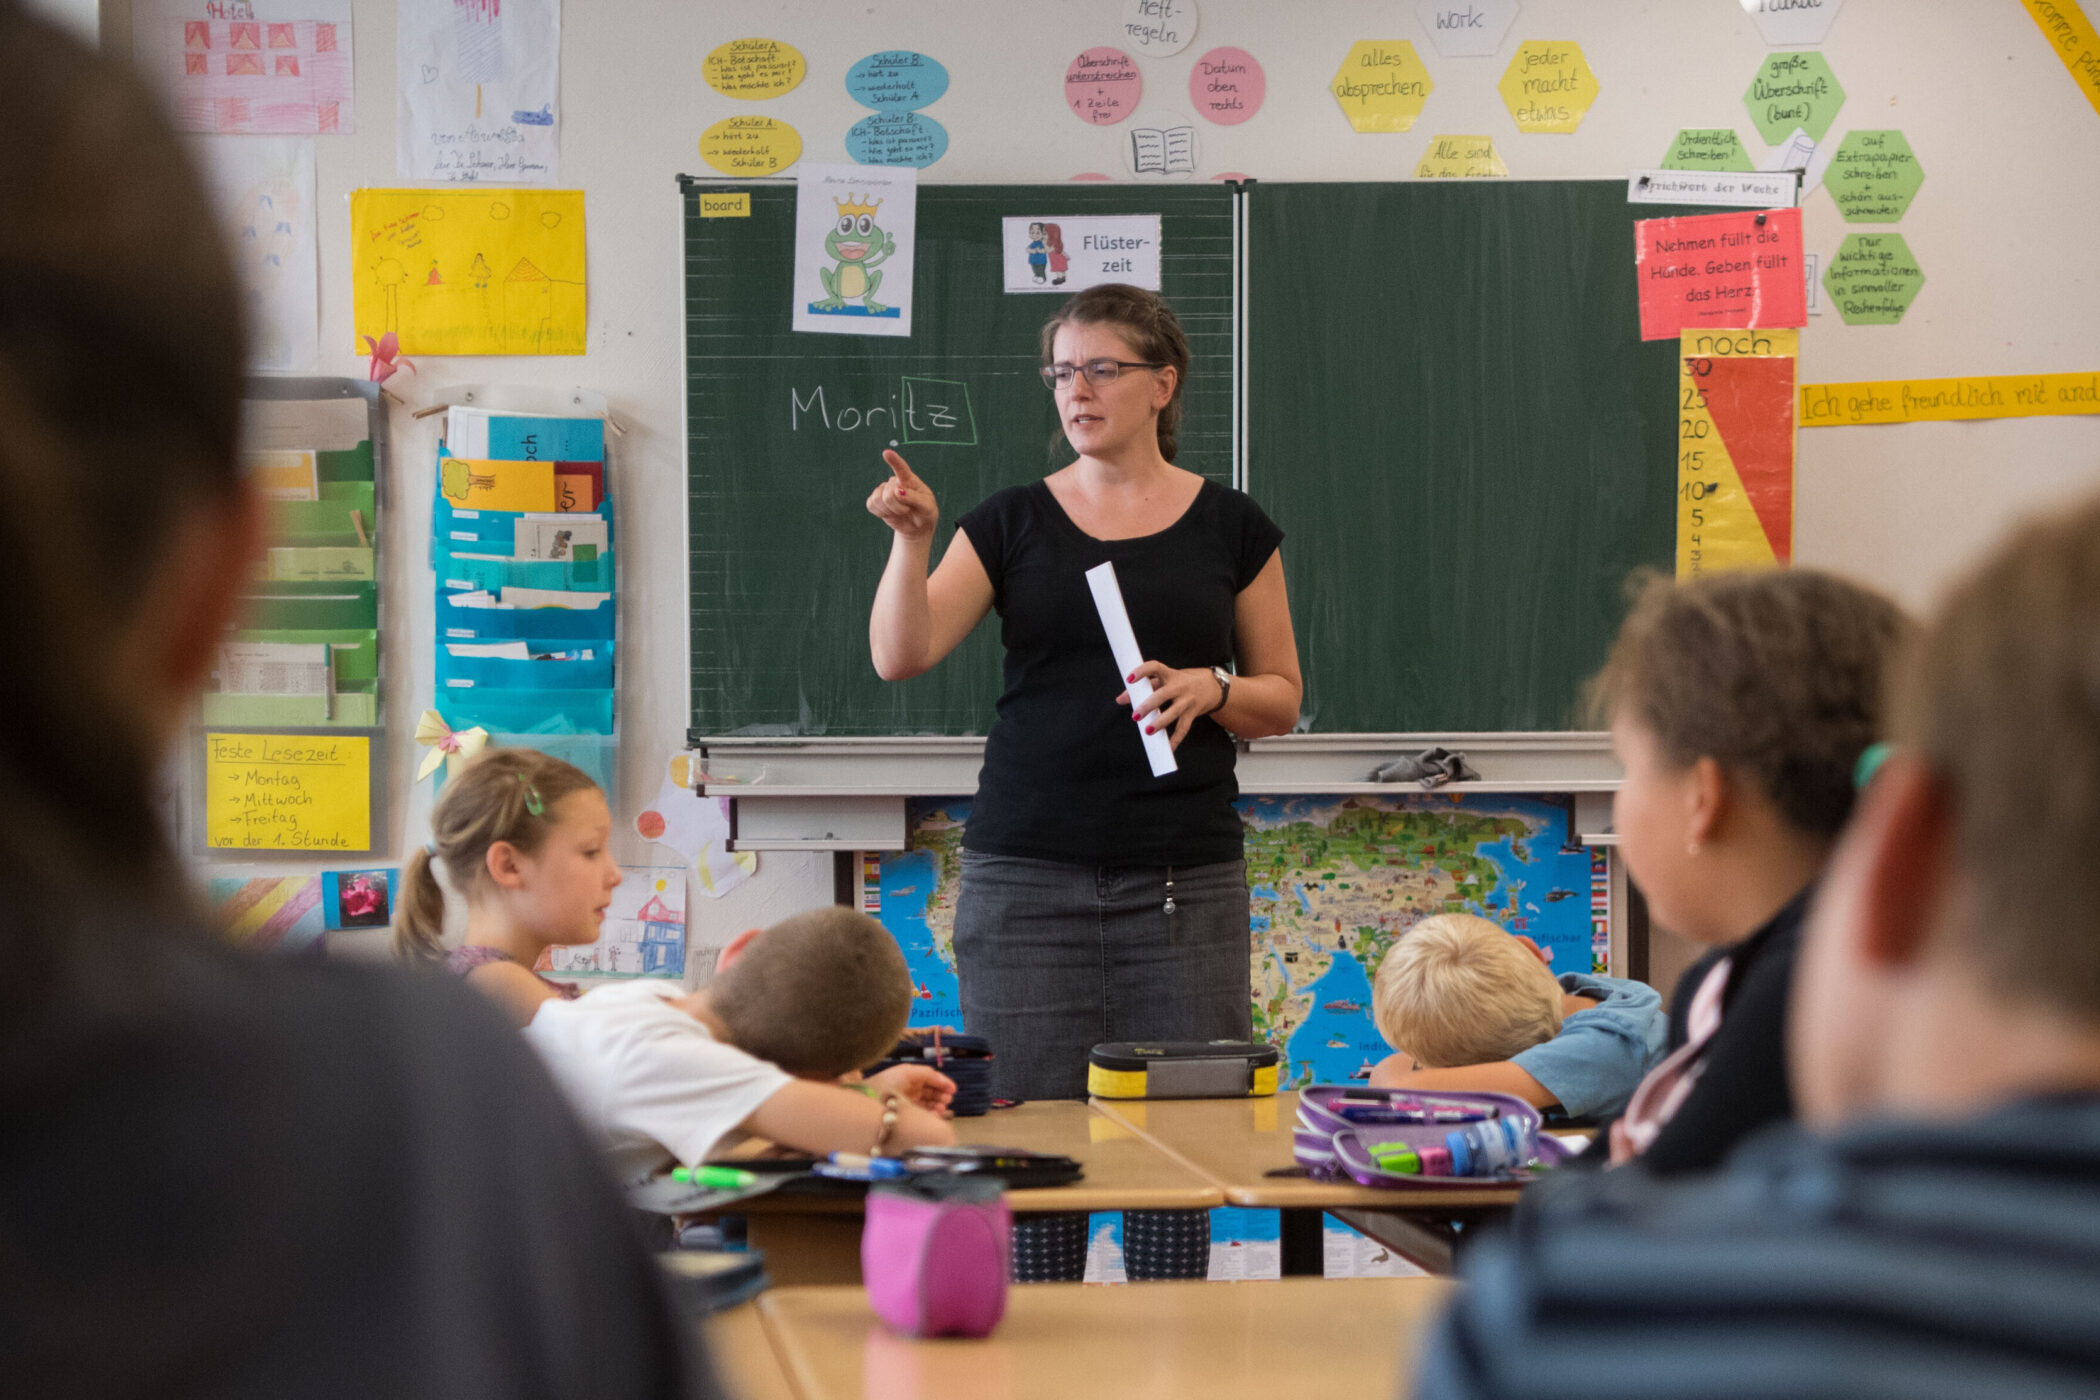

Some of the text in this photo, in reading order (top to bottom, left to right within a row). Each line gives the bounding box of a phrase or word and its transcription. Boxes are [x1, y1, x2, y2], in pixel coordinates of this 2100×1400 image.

[1437, 5, 1483, 29] work
[1124, 21, 1178, 45] regeln
[1078, 54, 1130, 69] Überschrift
[1200, 59, 1246, 75] Datum
[1361, 48, 1401, 67] alles
[1520, 47, 1569, 74] jeder
[1770, 55, 1809, 78] große
[1066, 69, 1137, 82] unterstreichen
[1207, 78, 1238, 92] oben
[1522, 67, 1577, 94] macht
[1337, 72, 1424, 105] absprechen
[1754, 77, 1828, 100] Überschrift
[1088, 97, 1119, 108] Zeile
[1208, 97, 1244, 110] rechts
[1517, 100, 1570, 122] etwas
[1767, 101, 1810, 124] (bunt)
[1679, 130, 1737, 146] Ordentlich
[1862, 133, 1885, 148] auf
[1433, 140, 1492, 160] Alle sind
[1837, 151, 1912, 168] Extrapapier
[1843, 166, 1898, 180] schreiben
[1714, 181, 1735, 193] der
[1742, 183, 1779, 195] Woche
[704, 198, 743, 212] board
[1083, 235, 1151, 250] Flüster-
[1656, 230, 1779, 253] Nehmen füllt die
[1102, 258, 1133, 273] zeit
[1705, 259, 1751, 275] Geben
[1757, 254, 1788, 269] füllt
[1840, 249, 1894, 267] wichtige
[1830, 265, 1919, 280] Informationen
[1686, 288, 1710, 302] das
[1835, 280, 1904, 296] in sinnvoller
[1843, 297, 1905, 318] Reihenfolge
[1697, 330, 1771, 355] noch
[1683, 358, 1712, 377] 30
[792, 381, 958, 431] Moritz
[1682, 388, 1709, 410] 25
[1802, 385, 1841, 420] Ich
[1848, 387, 1893, 421] gehe
[1901, 381, 2004, 417] freundlich
[2014, 378, 2049, 405] mit
[1681, 419, 1709, 439] 20
[1681, 451, 1705, 471] 15
[1680, 481, 1705, 501] 10
[1691, 509, 1704, 527] 5
[1691, 533, 1701, 547] 4
[211, 738, 253, 758] Feste
[244, 769, 300, 789] Montag
[243, 791, 312, 808] Mittwoch
[242, 809, 298, 831] Freitag
[214, 831, 350, 847] vor der 1. Stunde
